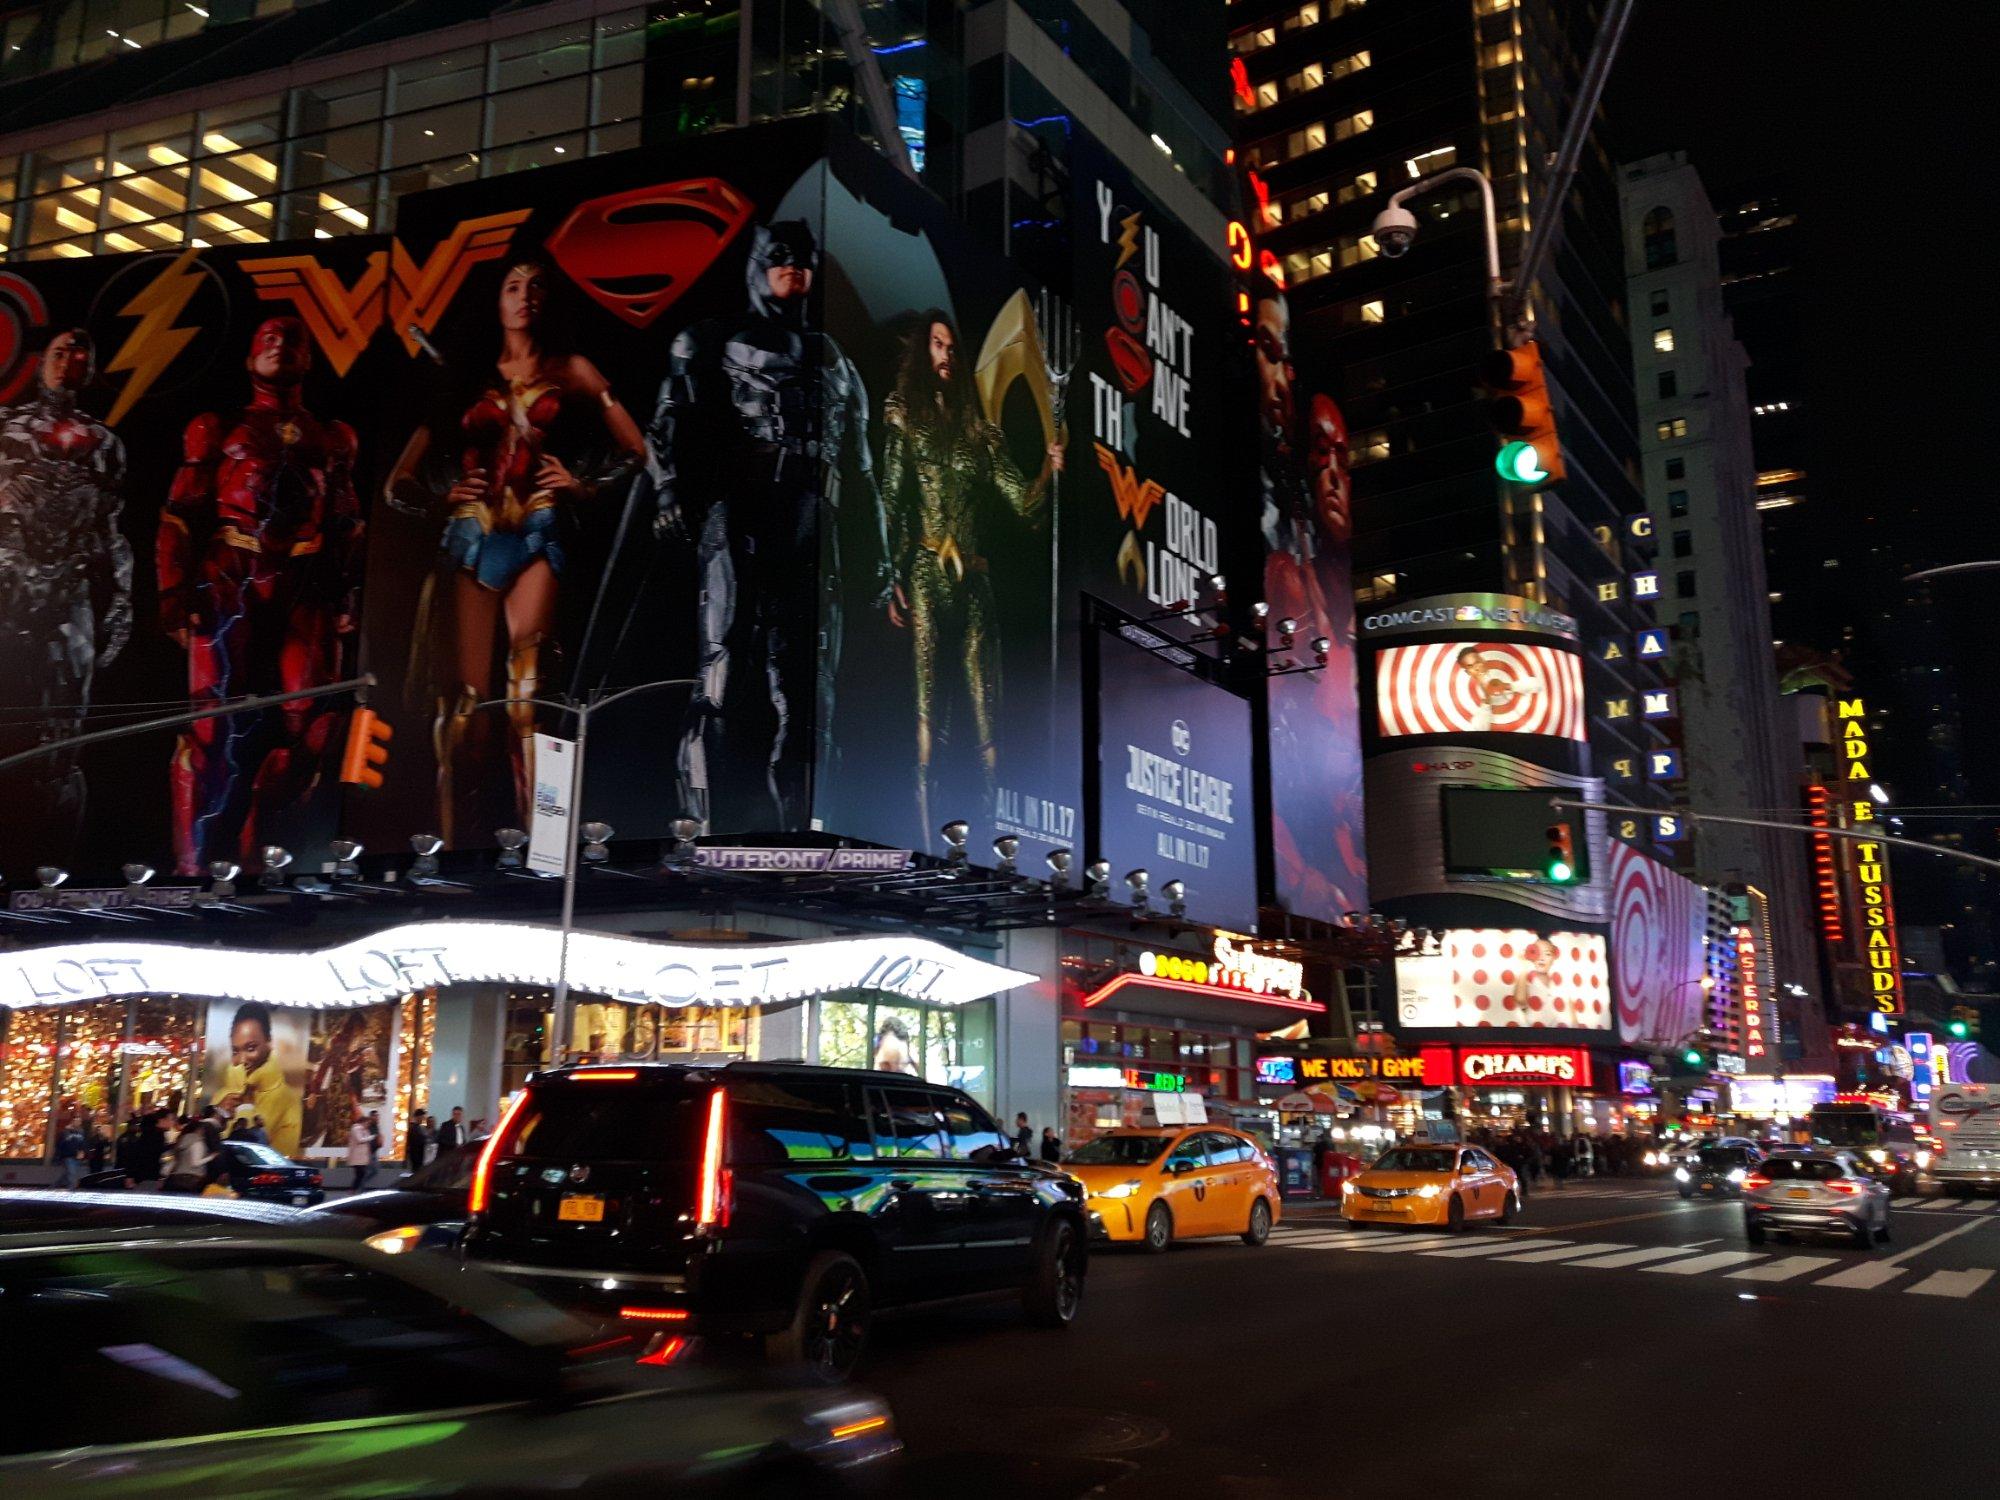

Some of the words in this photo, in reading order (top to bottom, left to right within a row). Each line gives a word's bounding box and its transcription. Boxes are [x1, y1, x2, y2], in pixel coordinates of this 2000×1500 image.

[1364, 607, 1455, 630] COMCAST
[1630, 517, 1677, 838] CHAMPS
[1126, 744, 1182, 807] JUSTICE
[1182, 766, 1234, 824] LEAGUE
[995, 787, 1021, 824] ALL
[1041, 800, 1075, 838] 11.17
[695, 850, 822, 868] OUTFRONT
[838, 853, 902, 868] PRIME
[1838, 698, 1874, 822] MADAE
[1857, 842, 1896, 1014] TUSSAUDS
[17, 958, 149, 998] LOFT
[327, 947, 451, 992] LOFT
[1301, 1058, 1328, 1078] WE
[1382, 1058, 1425, 1077] GAME
[1464, 1054, 1574, 1080] CHAMPS
